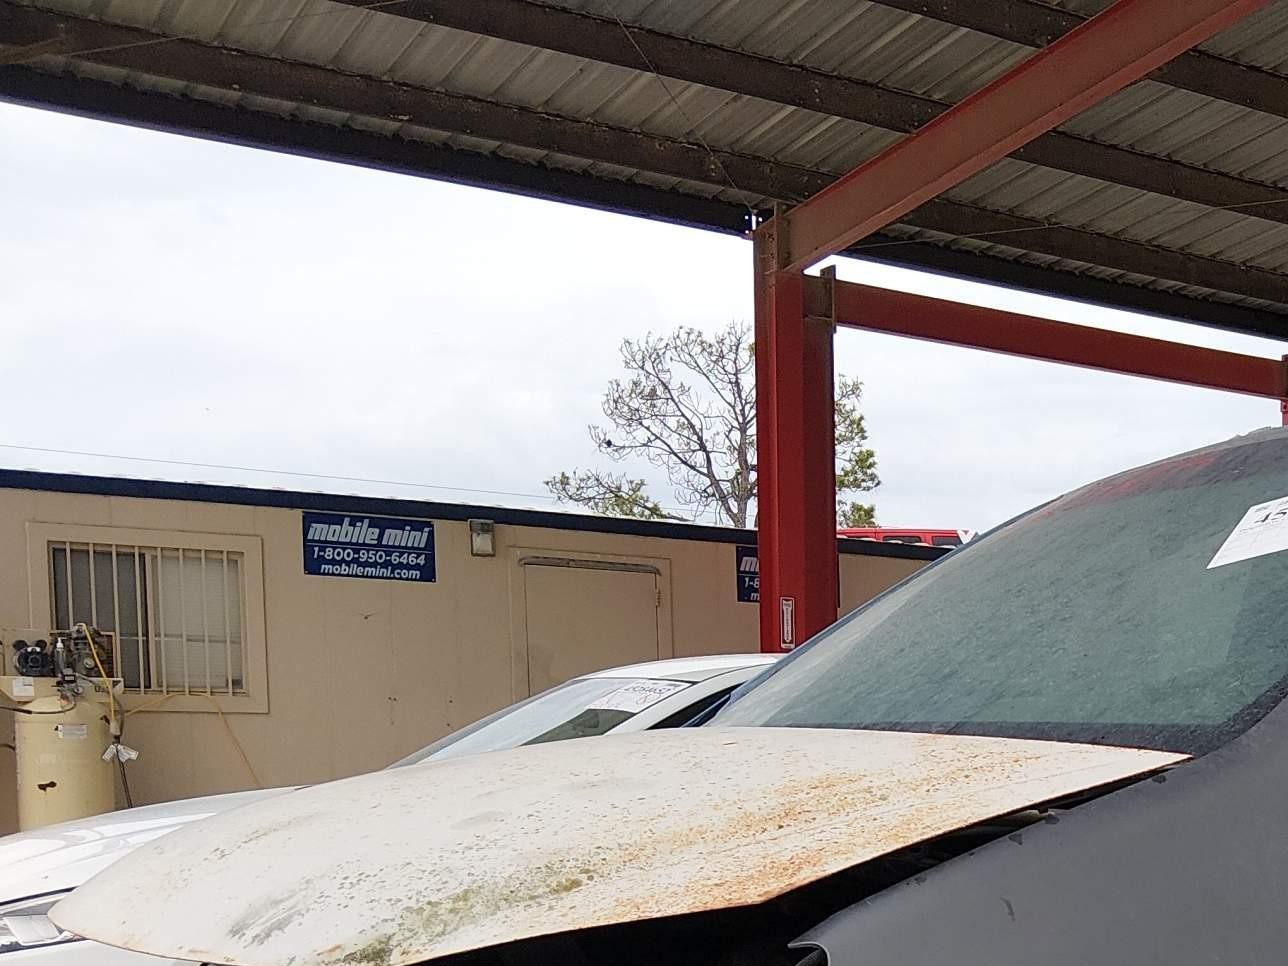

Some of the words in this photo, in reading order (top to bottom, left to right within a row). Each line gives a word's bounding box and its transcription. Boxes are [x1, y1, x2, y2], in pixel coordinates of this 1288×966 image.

[307, 517, 379, 544] mobile
[382, 526, 430, 548] mini
[313, 547, 425, 566] 1-800-950-6464
[320, 563, 420, 579] mobilemini.com
